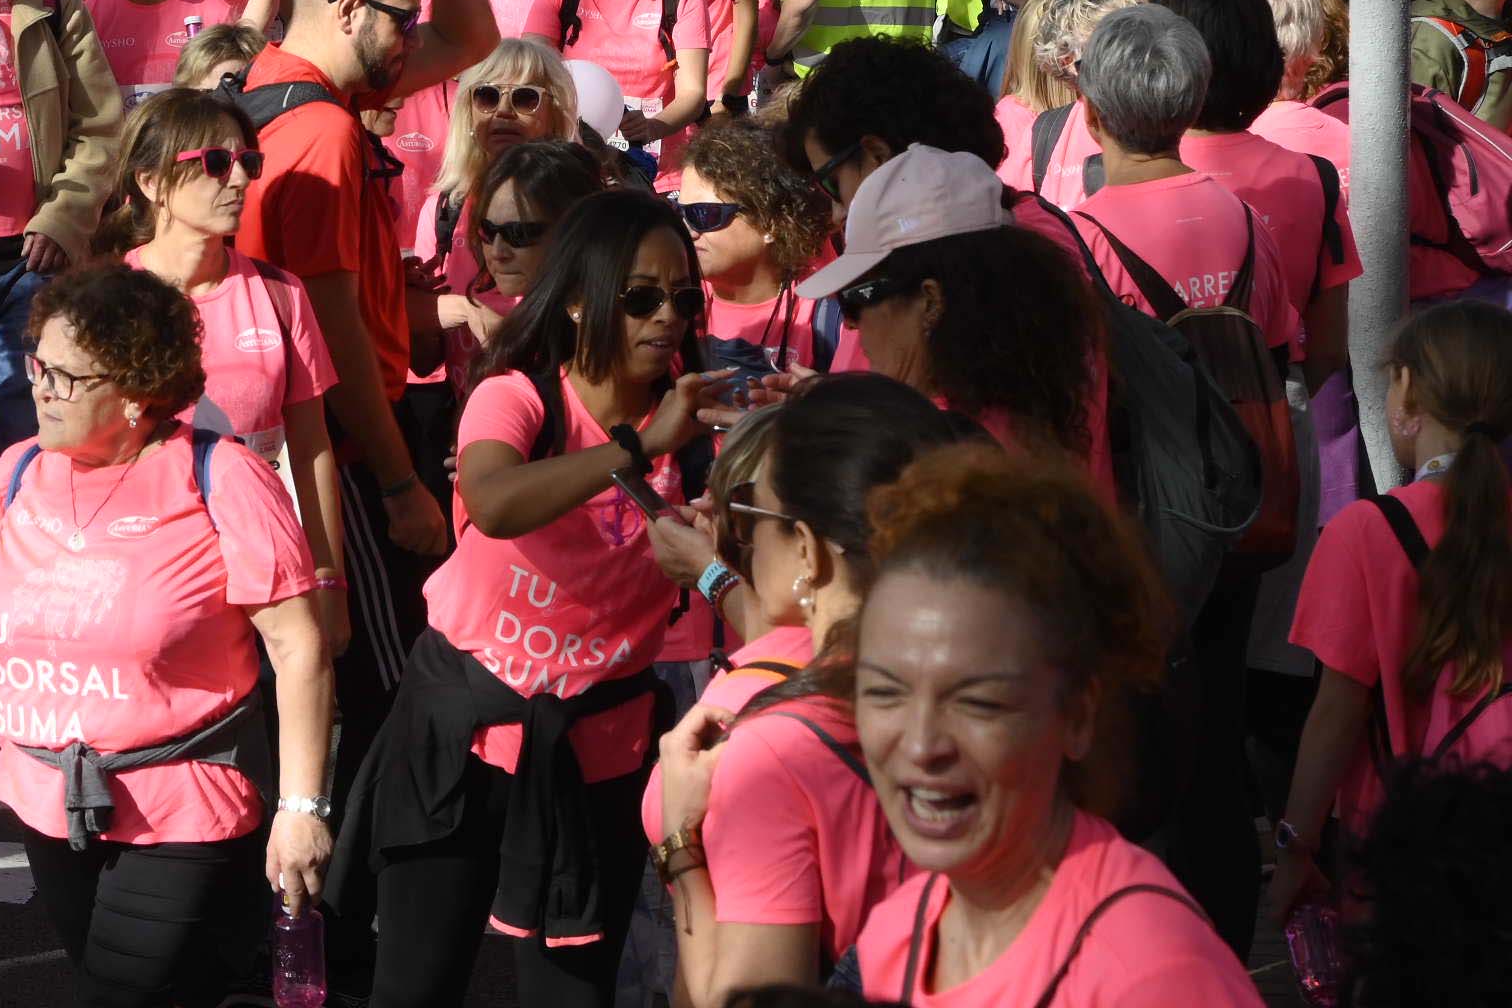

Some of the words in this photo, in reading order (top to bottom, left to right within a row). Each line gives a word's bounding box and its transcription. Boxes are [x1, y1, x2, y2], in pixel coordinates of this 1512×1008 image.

[1174, 270, 1240, 302] ARRE
[509, 564, 558, 608] TU
[495, 610, 632, 669] DORSA
[484, 647, 583, 700] SUM
